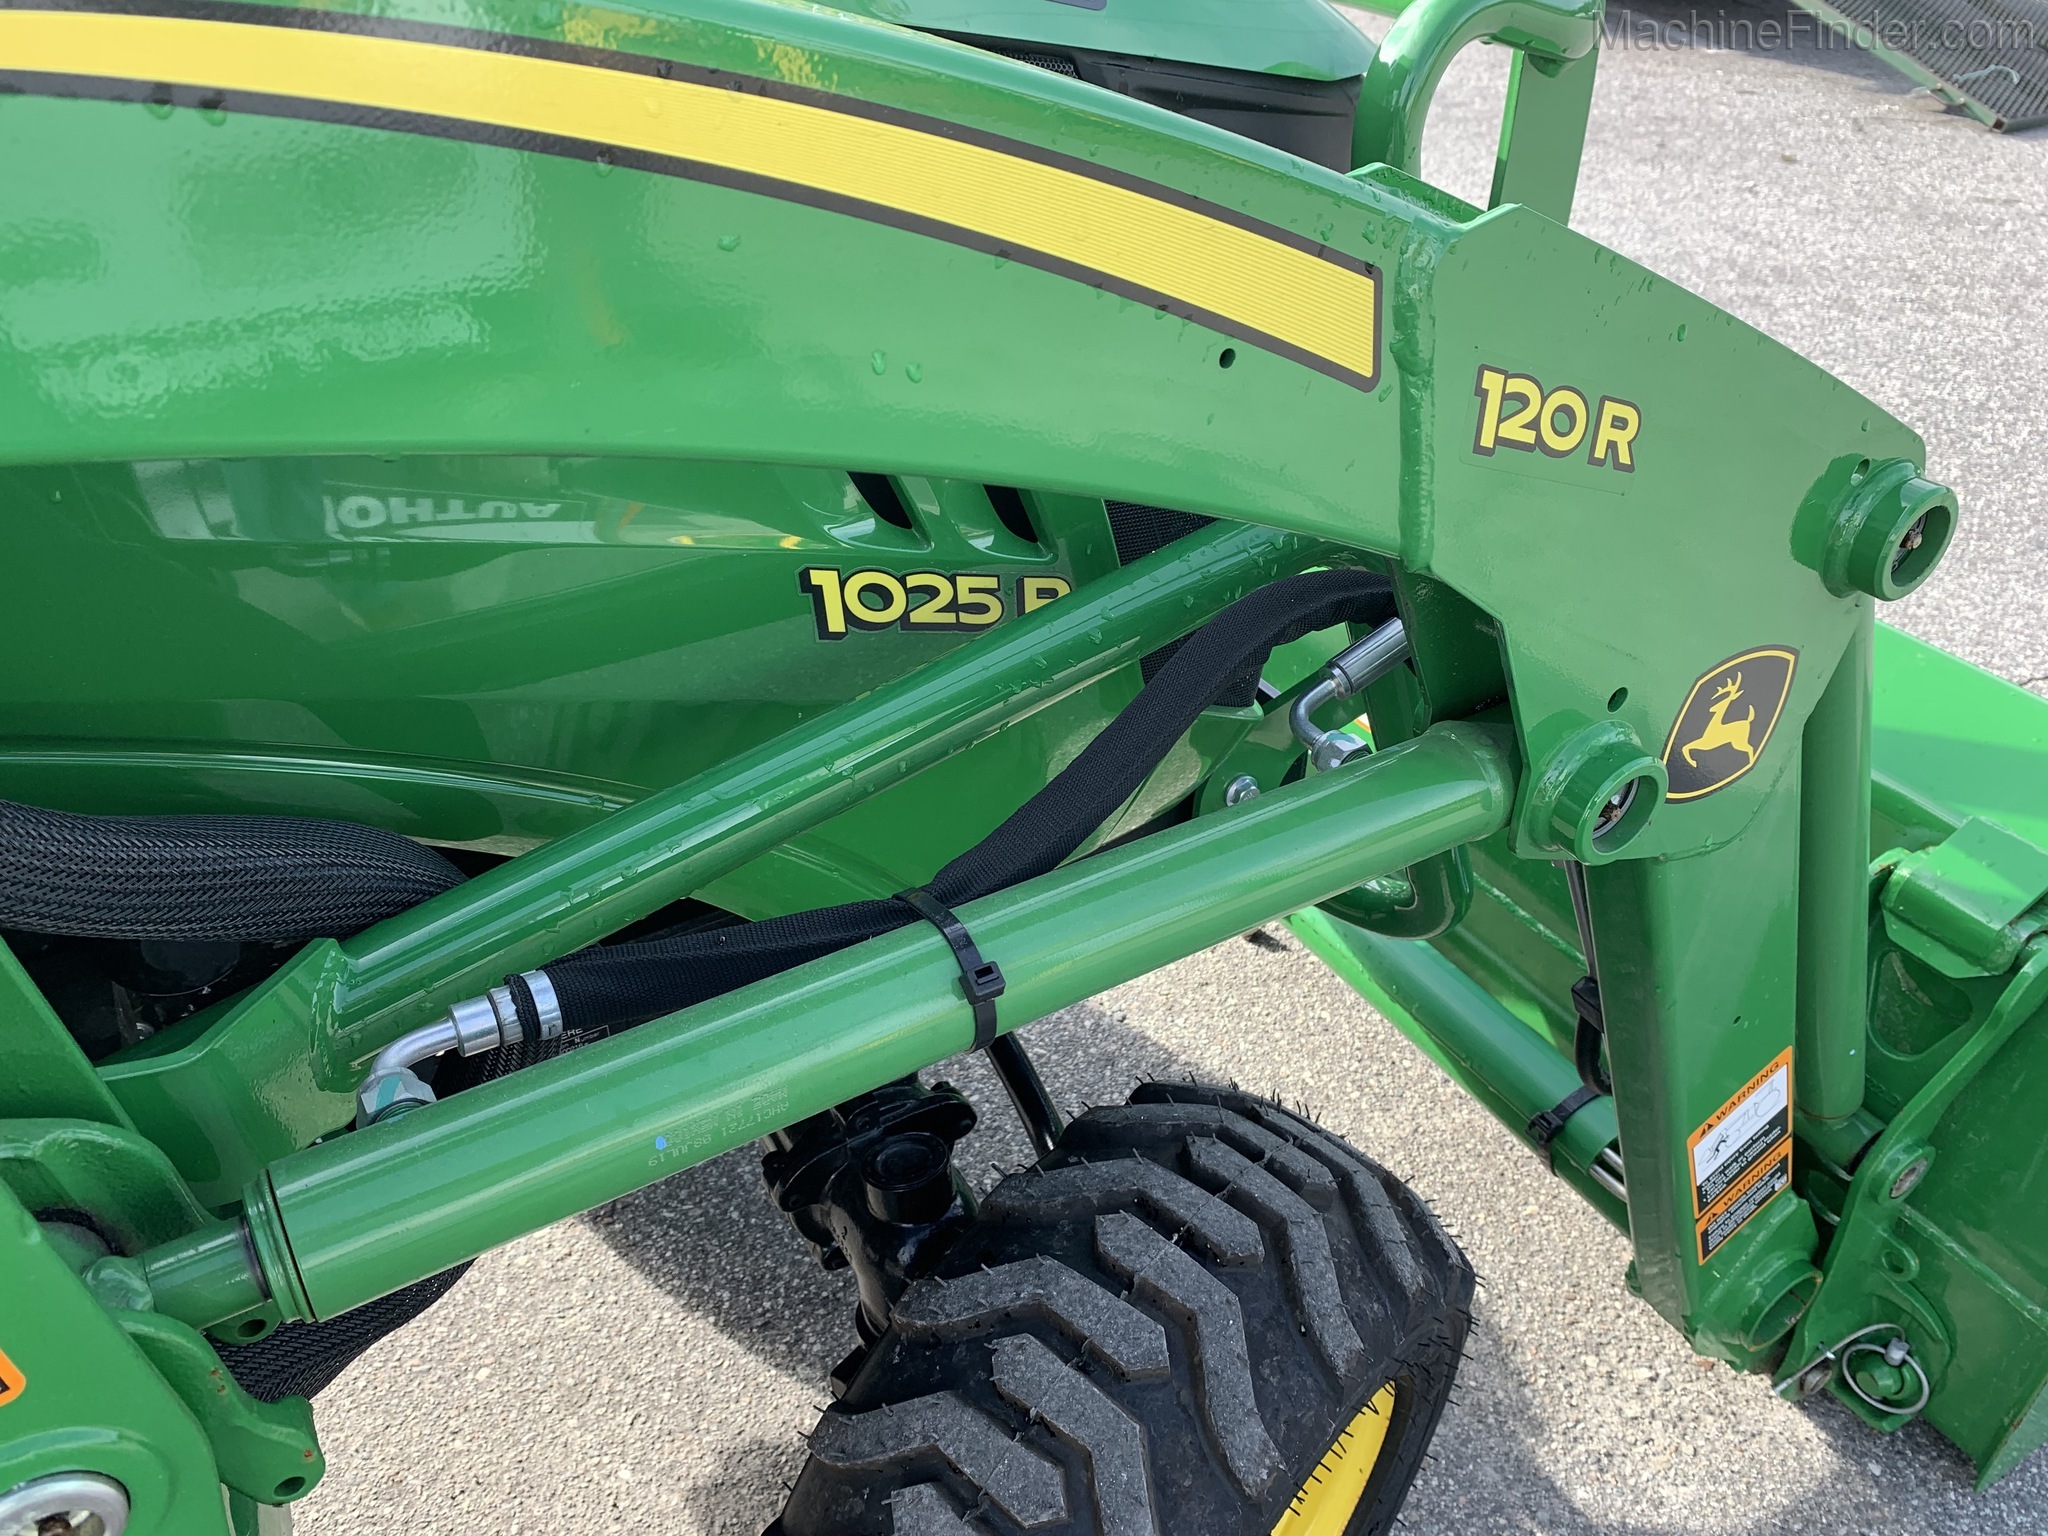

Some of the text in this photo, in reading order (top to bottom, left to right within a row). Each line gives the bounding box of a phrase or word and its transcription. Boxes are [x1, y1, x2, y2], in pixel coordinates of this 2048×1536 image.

[1473, 364, 1641, 473] 120 R
[322, 494, 562, 534] AUTHO
[799, 566, 1004, 640] 1025
[1716, 1061, 1780, 1122] WARNING
[1723, 1151, 1782, 1206] WARNING
